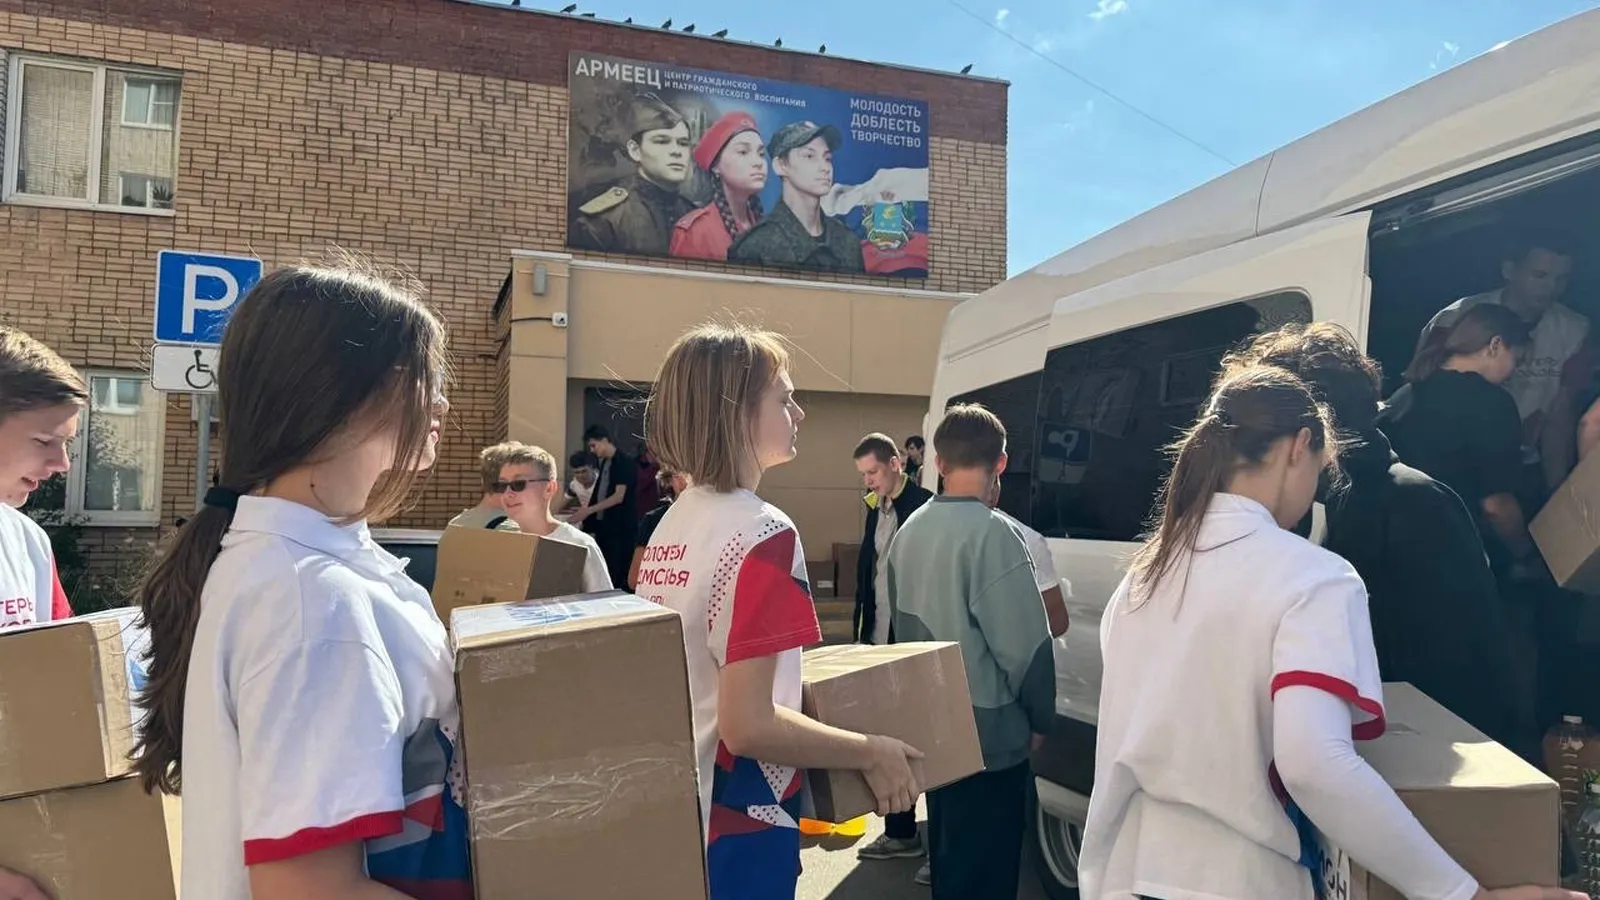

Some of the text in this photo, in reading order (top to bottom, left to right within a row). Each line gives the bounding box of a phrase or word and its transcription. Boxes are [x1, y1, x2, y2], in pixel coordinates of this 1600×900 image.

[575, 57, 662, 90] АРМЕЕЦ
[664, 70, 757, 91] ЦЕНТР ГРАЖДАНСКОГО
[672, 82, 751, 100] ПАТРИОТИЧЕСКОГО
[754, 94, 806, 108] ВОСПИТАНИЯ
[850, 98, 921, 118] МОЛОДОСТЬ
[850, 113, 921, 133] ДОБЛЕСТЬ
[850, 129, 921, 148] ТВОРЧЕСТВО
[181, 263, 239, 334] P
